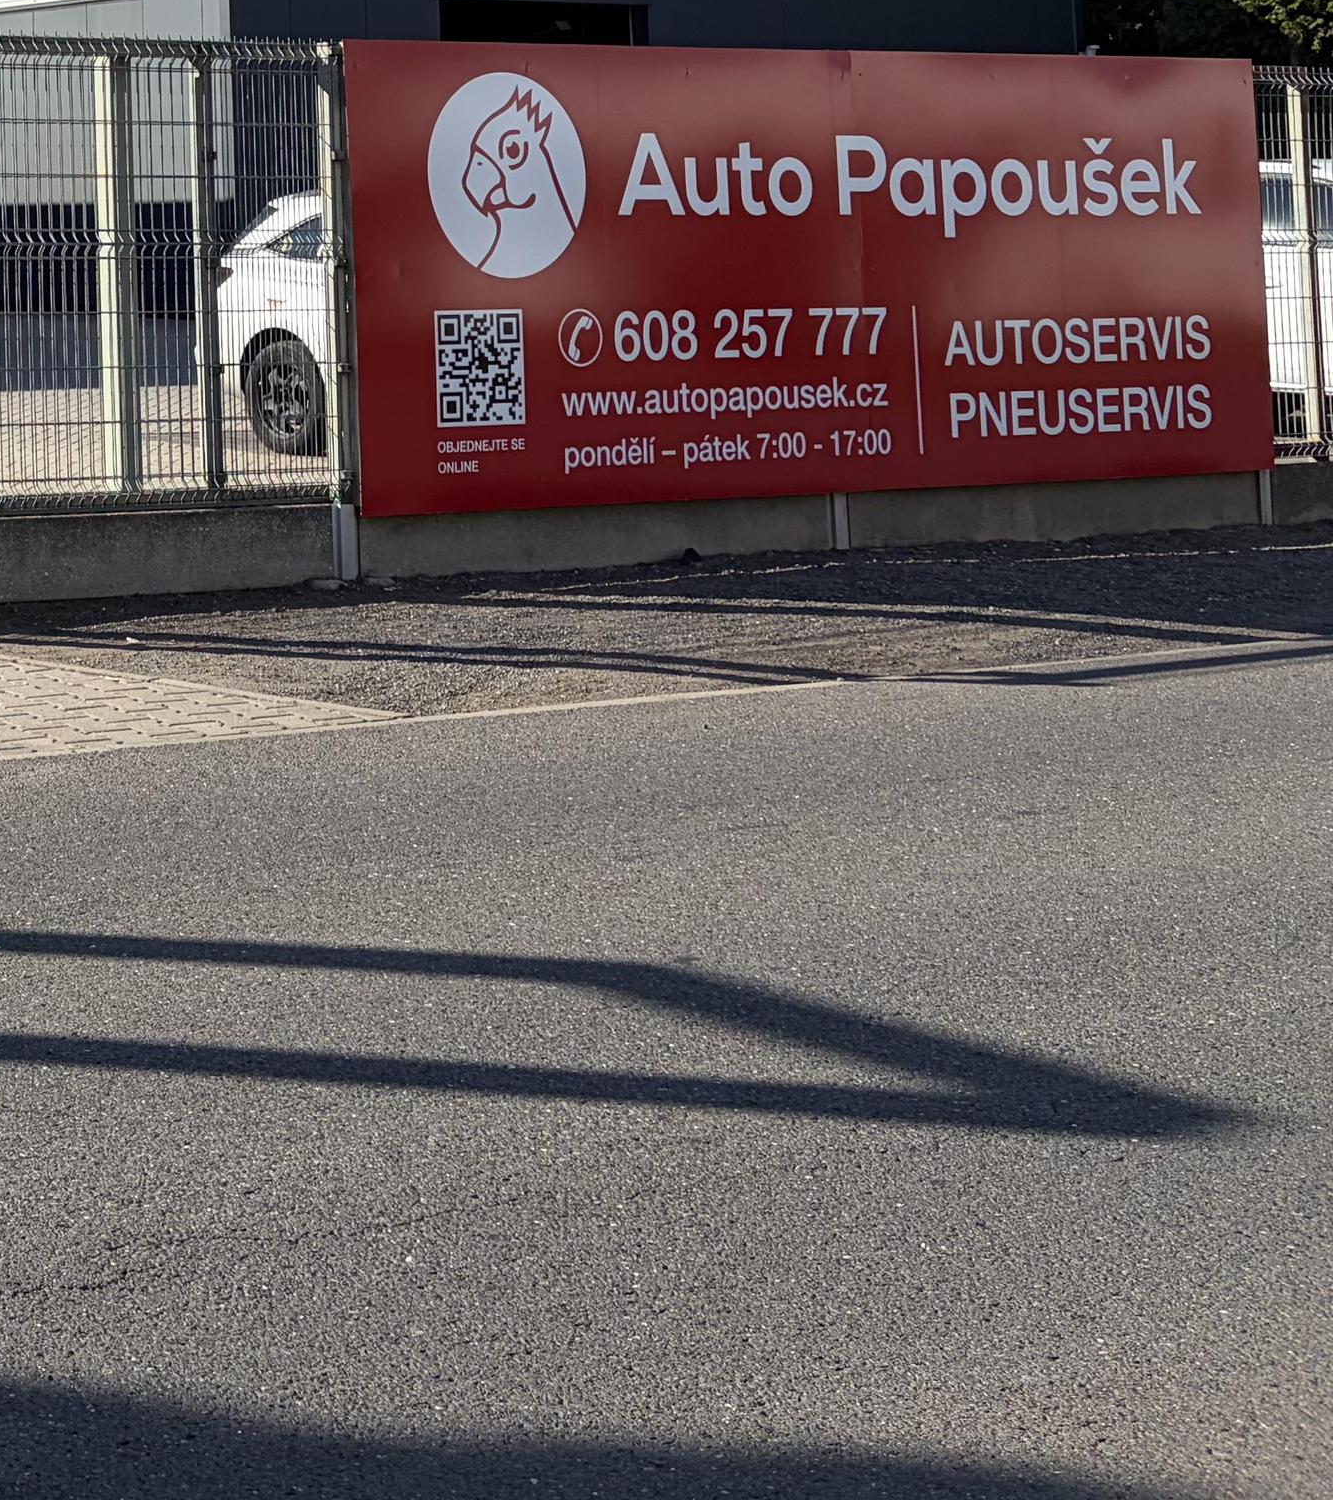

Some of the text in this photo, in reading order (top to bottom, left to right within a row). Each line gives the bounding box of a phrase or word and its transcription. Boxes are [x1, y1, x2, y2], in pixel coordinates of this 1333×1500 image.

[618, 132, 1203, 238] Auto Papoušek
[614, 306, 887, 362] 608 257 777
[944, 314, 1212, 366] AUTOSERVIS
[561, 376, 889, 419] www.autopapousek.cz
[949, 383, 1213, 439] PNEUSERVIS
[437, 438, 526, 453] OBJEDNEJTE SE
[437, 460, 480, 474] ONLINE
[564, 436, 655, 474] pondělí
[683, 434, 751, 469] pátek
[756, 432, 807, 460] 7:00
[829, 429, 892, 457] 17:00
